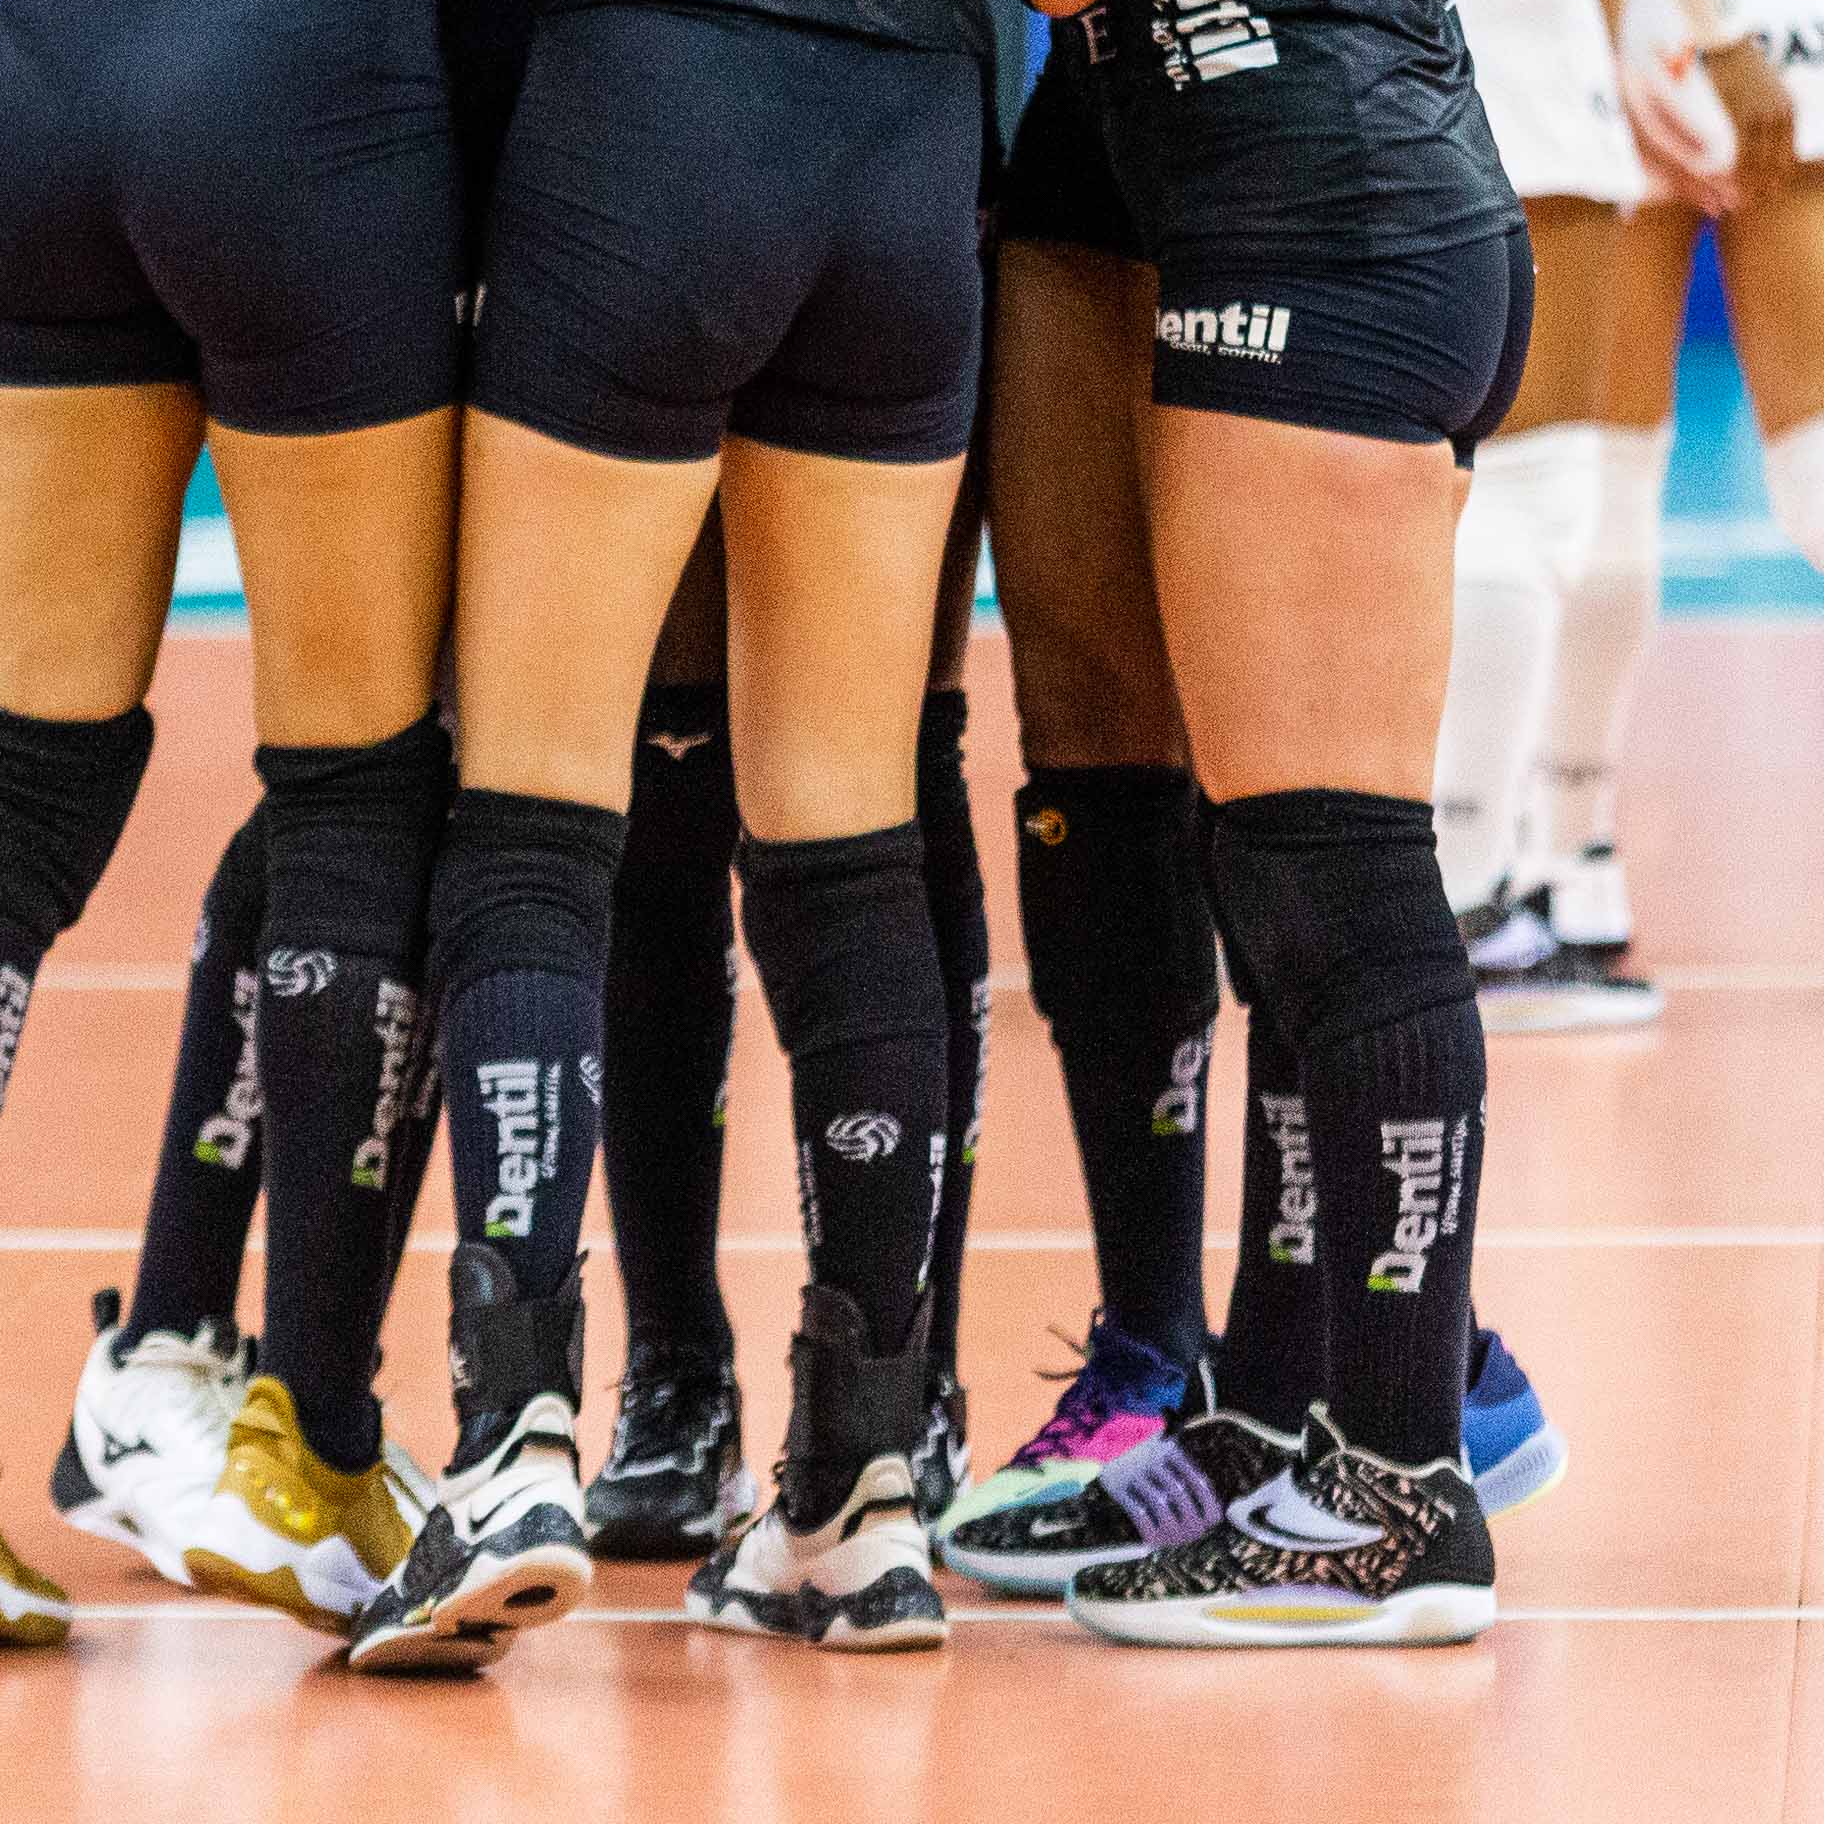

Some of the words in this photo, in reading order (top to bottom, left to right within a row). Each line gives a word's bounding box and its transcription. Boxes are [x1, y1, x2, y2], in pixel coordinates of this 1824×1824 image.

[1155, 302, 1290, 352] entil
[477, 1062, 540, 1237] Dentil
[1260, 1090, 1318, 1265] Dentil
[1366, 1119, 1445, 1294] Dentil
